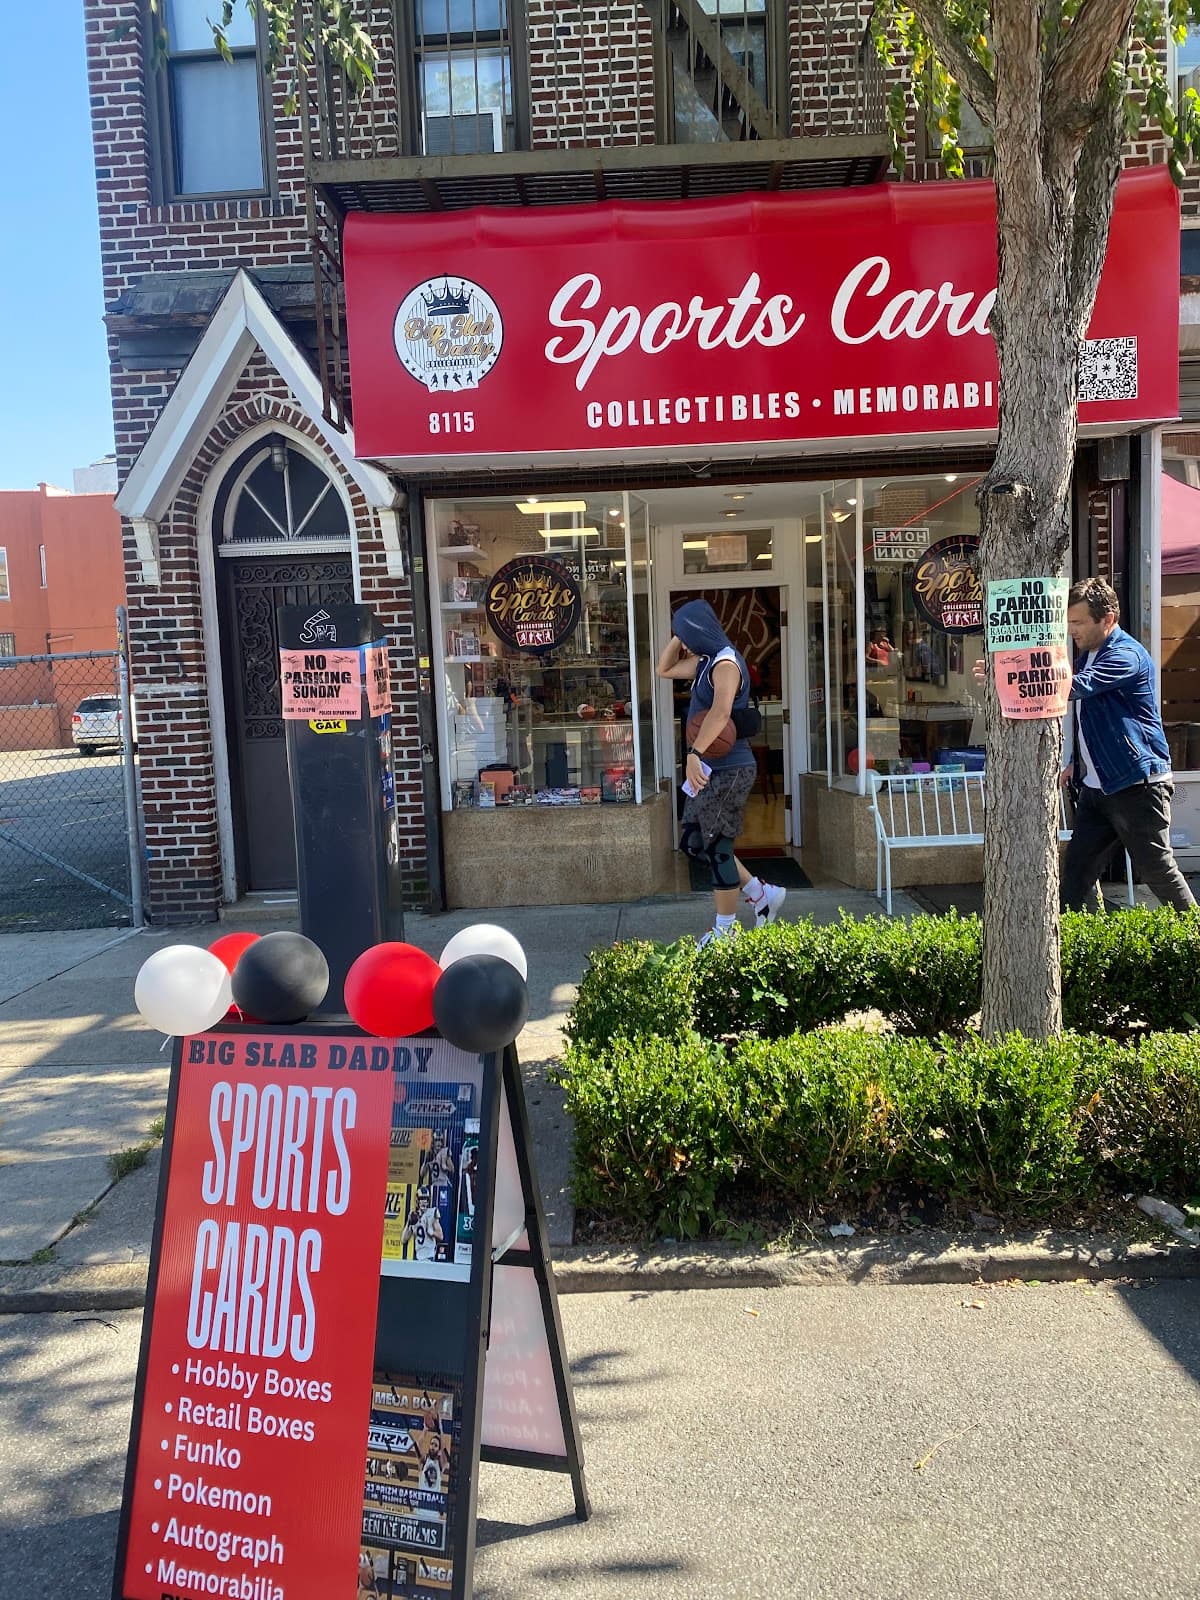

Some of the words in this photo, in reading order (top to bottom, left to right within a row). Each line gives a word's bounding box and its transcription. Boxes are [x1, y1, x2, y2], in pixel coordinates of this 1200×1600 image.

[404, 317, 446, 347] Big
[450, 313, 494, 339] Slab
[545, 272, 805, 391] Sports
[435, 337, 495, 361] Daddy
[587, 392, 800, 428] COLLECTIBLES
[834, 380, 1000, 415] MEMORABI
[429, 412, 474, 433] 8115
[915, 561, 981, 601] Spor
[1021, 581, 1044, 596] NO
[489, 582, 575, 620] Sports
[939, 586, 983, 602] Cards
[996, 595, 1062, 611] PARKING
[512, 606, 557, 622] Cards
[989, 609, 1065, 626] SATURDAY
[991, 634, 1011, 643] 7:00
[1014, 633, 1030, 642] AM
[304, 654, 327, 670] NO
[1030, 651, 1052, 668] NO
[284, 671, 352, 684] PARKING
[1007, 668, 1067, 685] PARKING
[293, 685, 341, 698] SUNDAY
[1019, 683, 1060, 698] SUNDA
[315, 722, 342, 730] GAK
[188, 1040, 235, 1065] BIG
[245, 1042, 317, 1069] SLAB
[328, 1045, 433, 1075] DADDY
[202, 1081, 357, 1216] SPORTS
[416, 1226, 425, 1245] 9
[186, 1219, 322, 1362] CARDS
[185, 1358, 258, 1398] Hobby
[265, 1369, 332, 1403] Boxes
[178, 1397, 241, 1431] Retail
[248, 1408, 315, 1442] Boxes
[368, 1431, 409, 1446] RIZM
[174, 1434, 241, 1469] Funko
[168, 1474, 272, 1517] Pokemon
[163, 1517, 284, 1568] Autograph
[157, 1558, 284, 1600] Memorabilia
